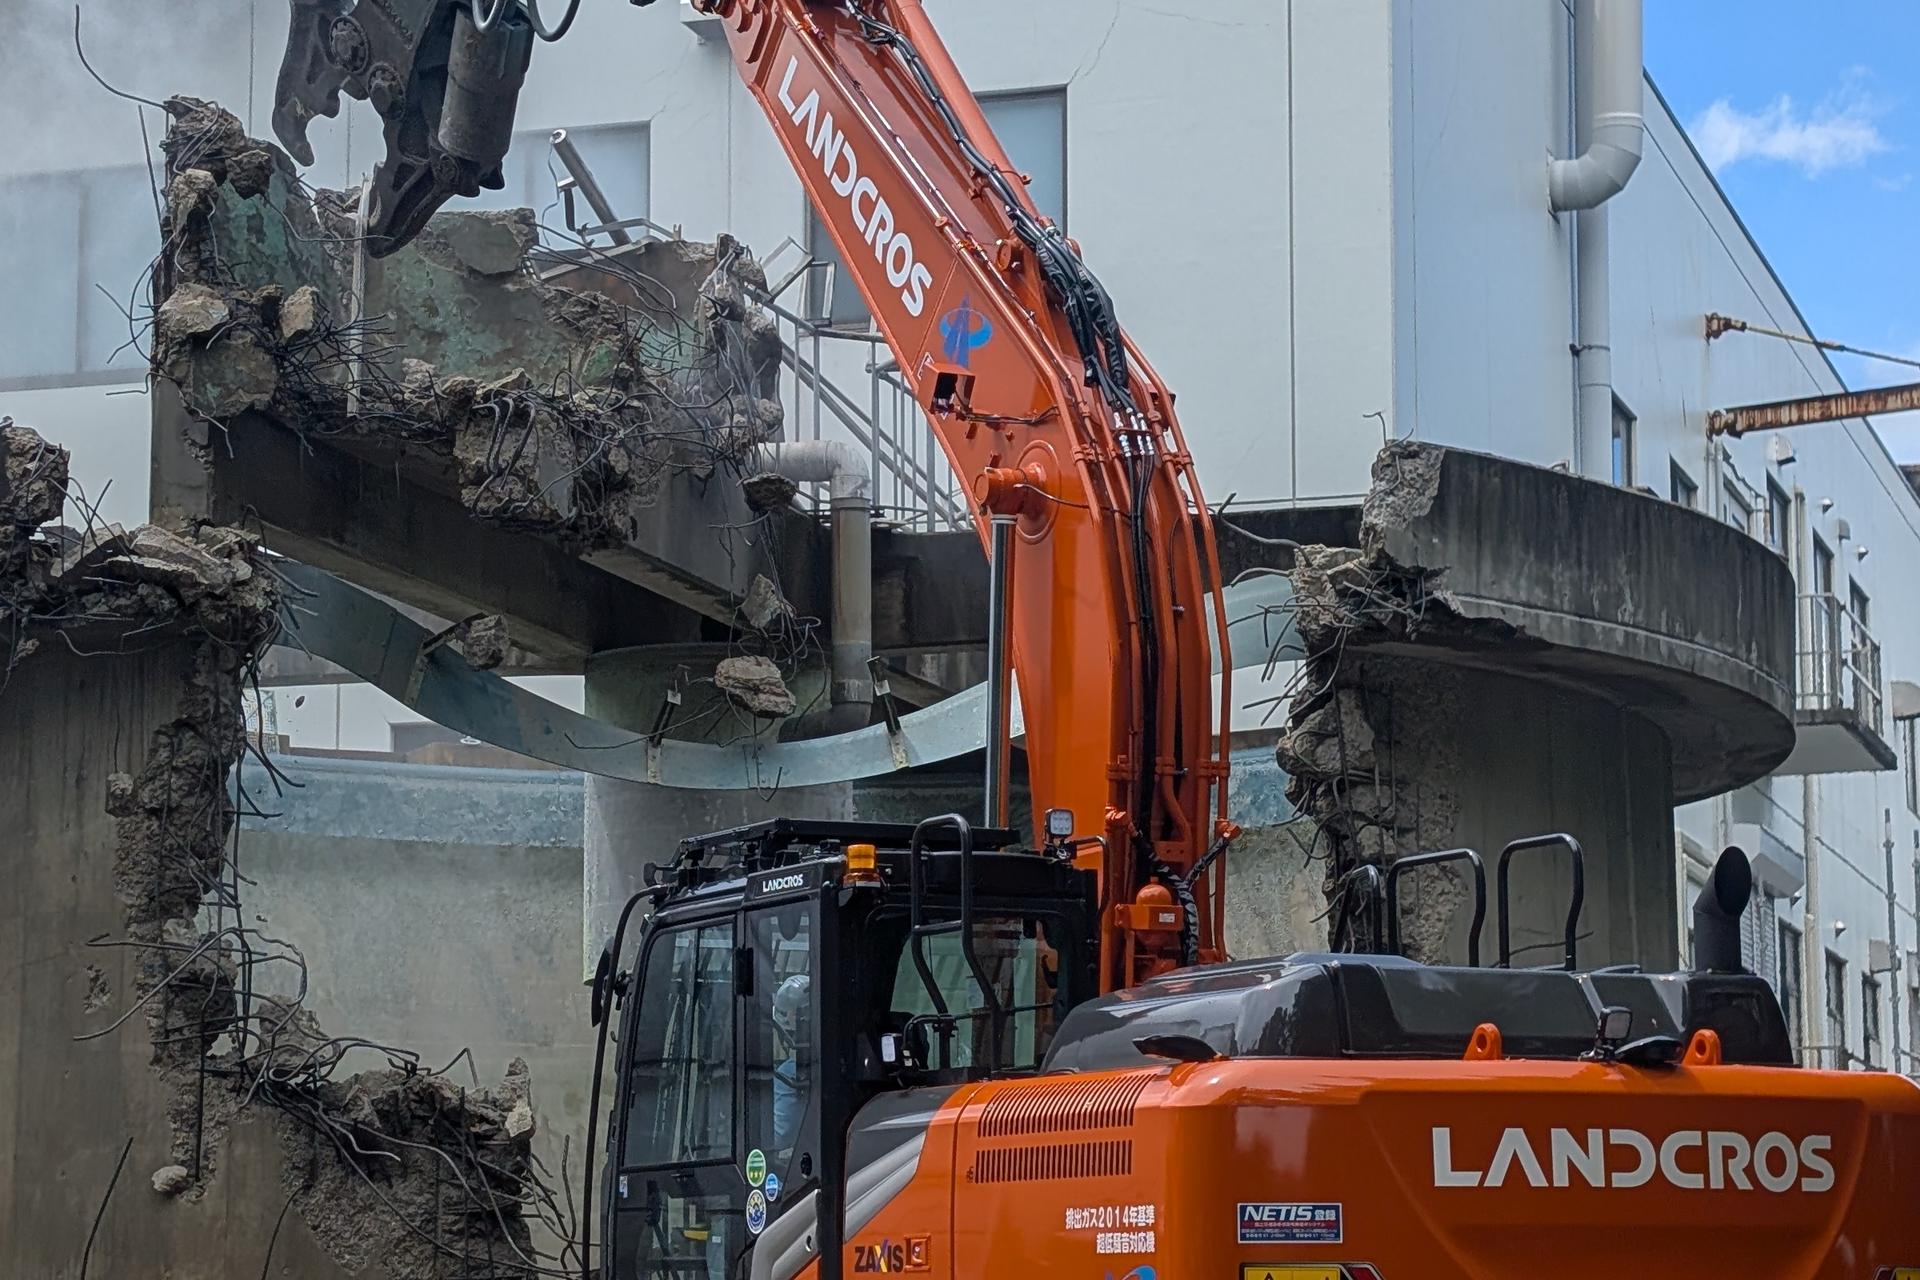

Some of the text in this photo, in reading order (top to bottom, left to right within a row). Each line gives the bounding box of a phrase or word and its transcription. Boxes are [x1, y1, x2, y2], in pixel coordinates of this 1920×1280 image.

[778, 55, 933, 317] LANDCROS
[763, 873, 804, 892] LANDCROS
[1432, 1127, 1836, 1193] LANDCROS
[1244, 1206, 1313, 1221] NETIS
[854, 1239, 904, 1273] ZAXIS
